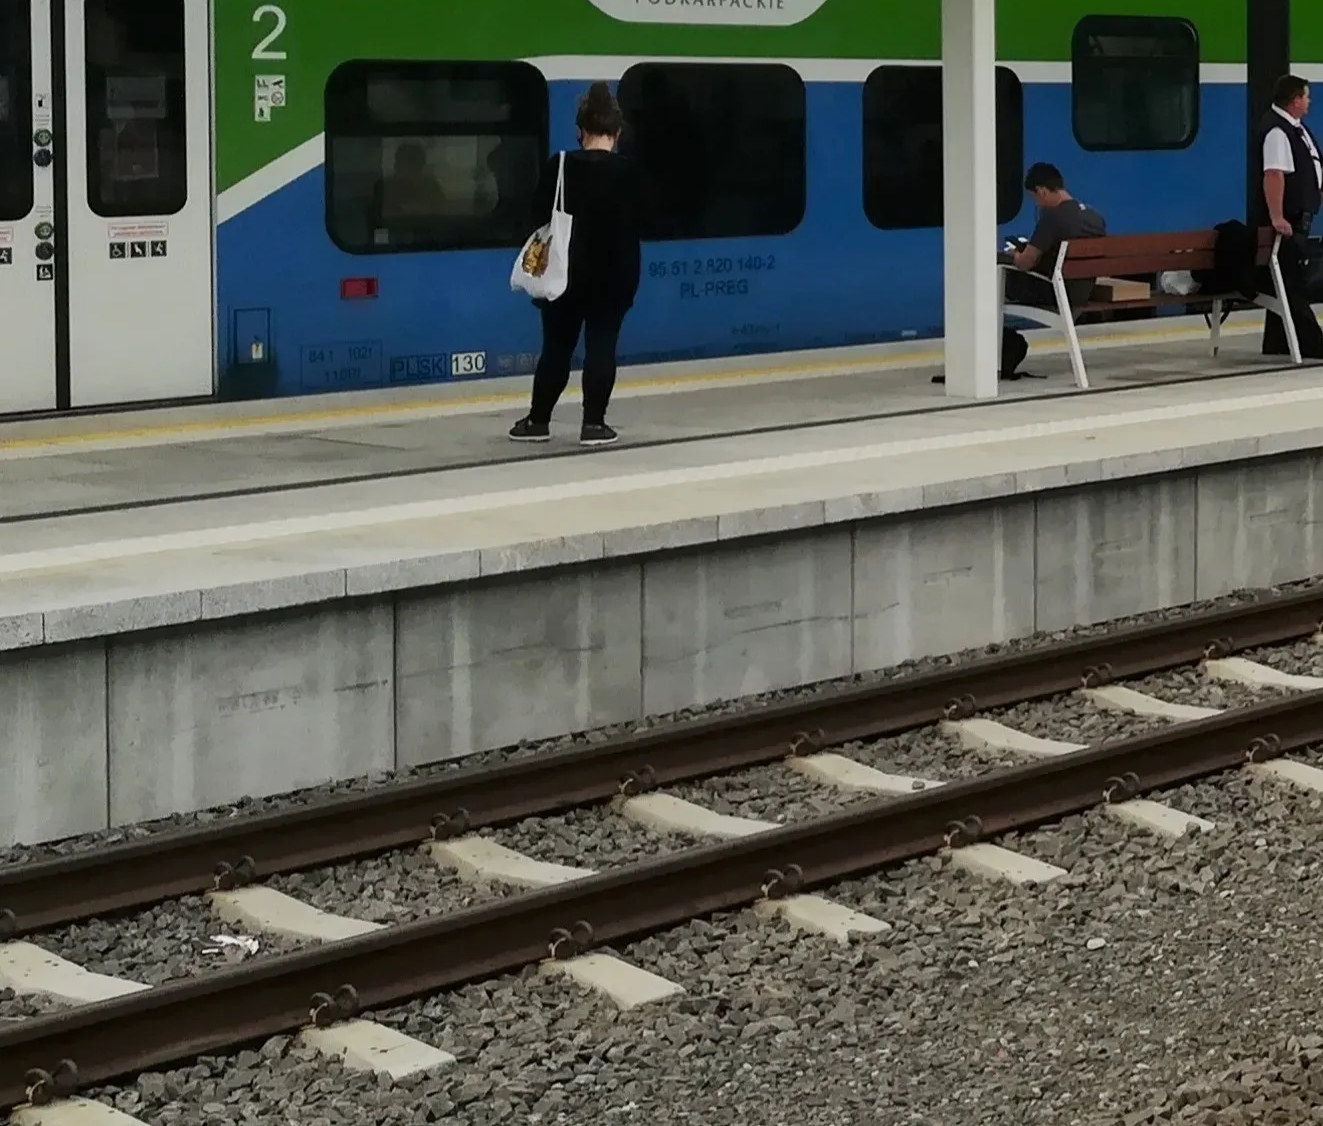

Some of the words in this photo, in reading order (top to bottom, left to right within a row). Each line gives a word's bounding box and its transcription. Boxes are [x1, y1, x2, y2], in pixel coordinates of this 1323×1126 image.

[251, 3, 287, 60] 2
[694, 259, 702, 274] 2
[680, 279, 750, 299] PL-PREG
[452, 354, 486, 373] 130
